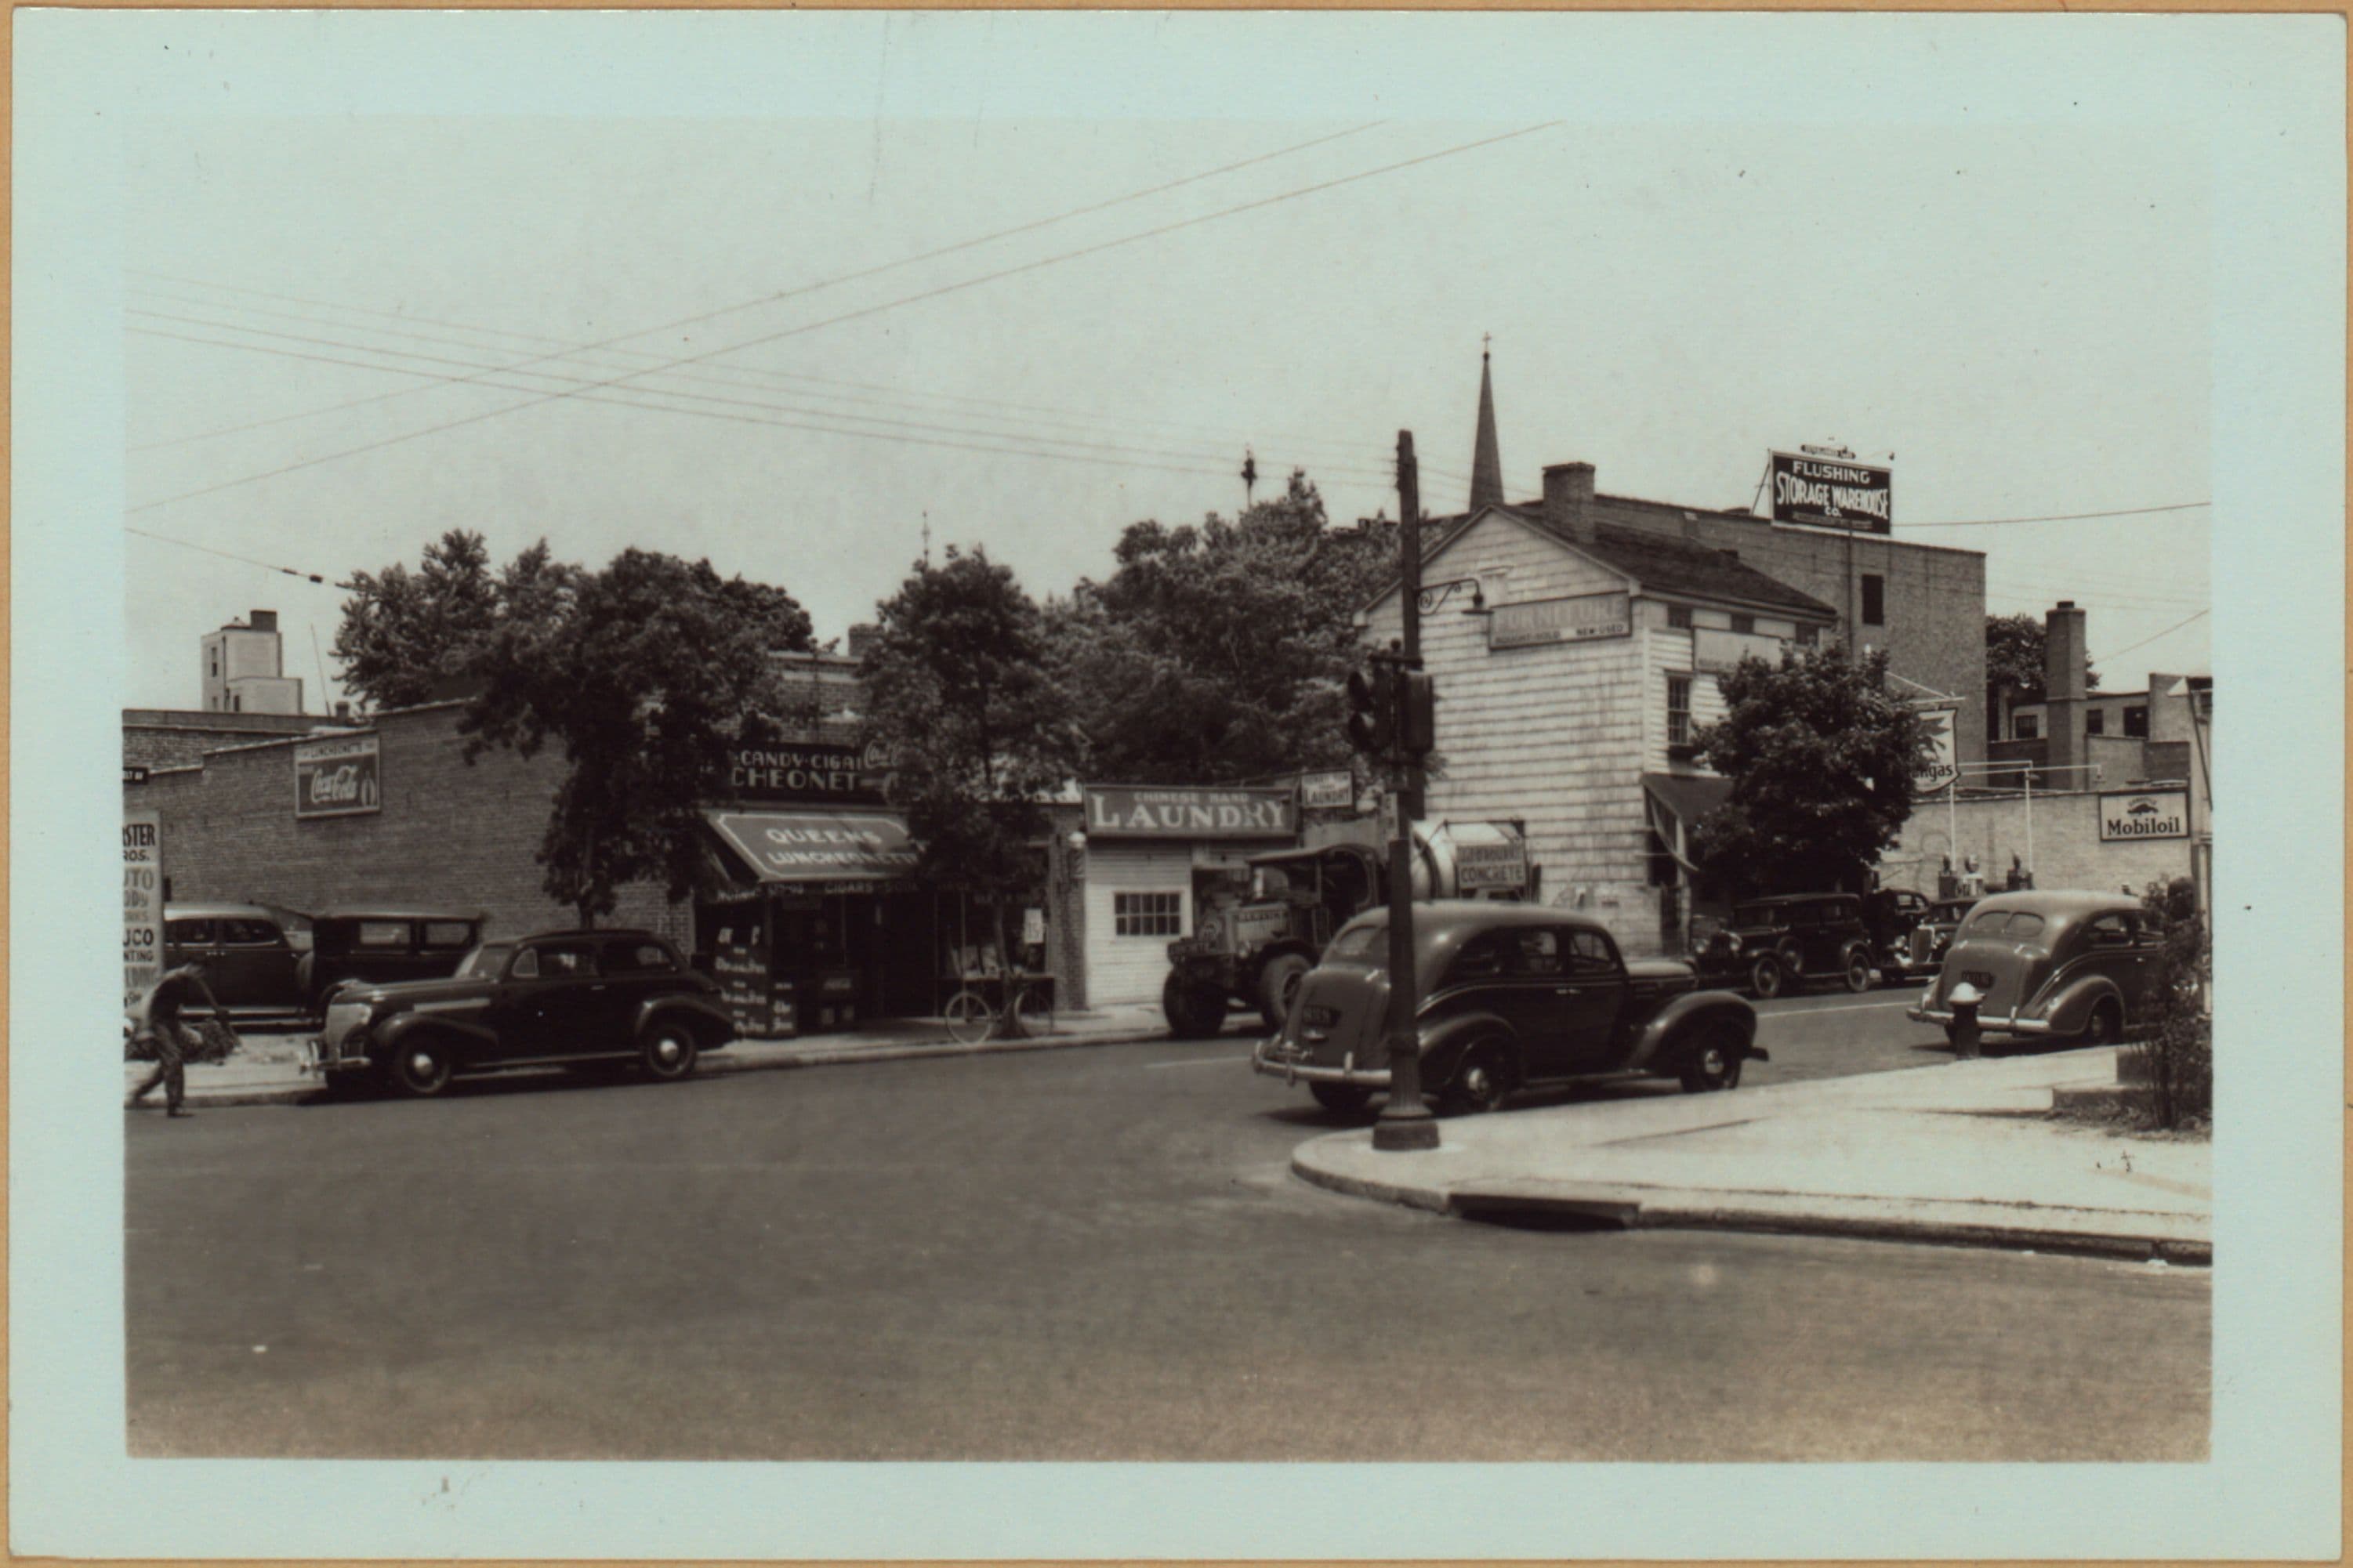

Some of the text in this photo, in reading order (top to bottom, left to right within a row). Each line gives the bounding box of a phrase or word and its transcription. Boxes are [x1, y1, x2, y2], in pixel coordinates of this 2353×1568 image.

[1793, 460, 1871, 484] FLUSHING
[1775, 471, 1829, 506] STORAGE
[1832, 485, 1888, 520] WAREHOUSE
[1091, 793, 1285, 829] LAUNDRY
[766, 828, 883, 845] QUEENS
[2107, 816, 2180, 836] Mobiloil
[1460, 864, 1525, 883] CONCRETE
